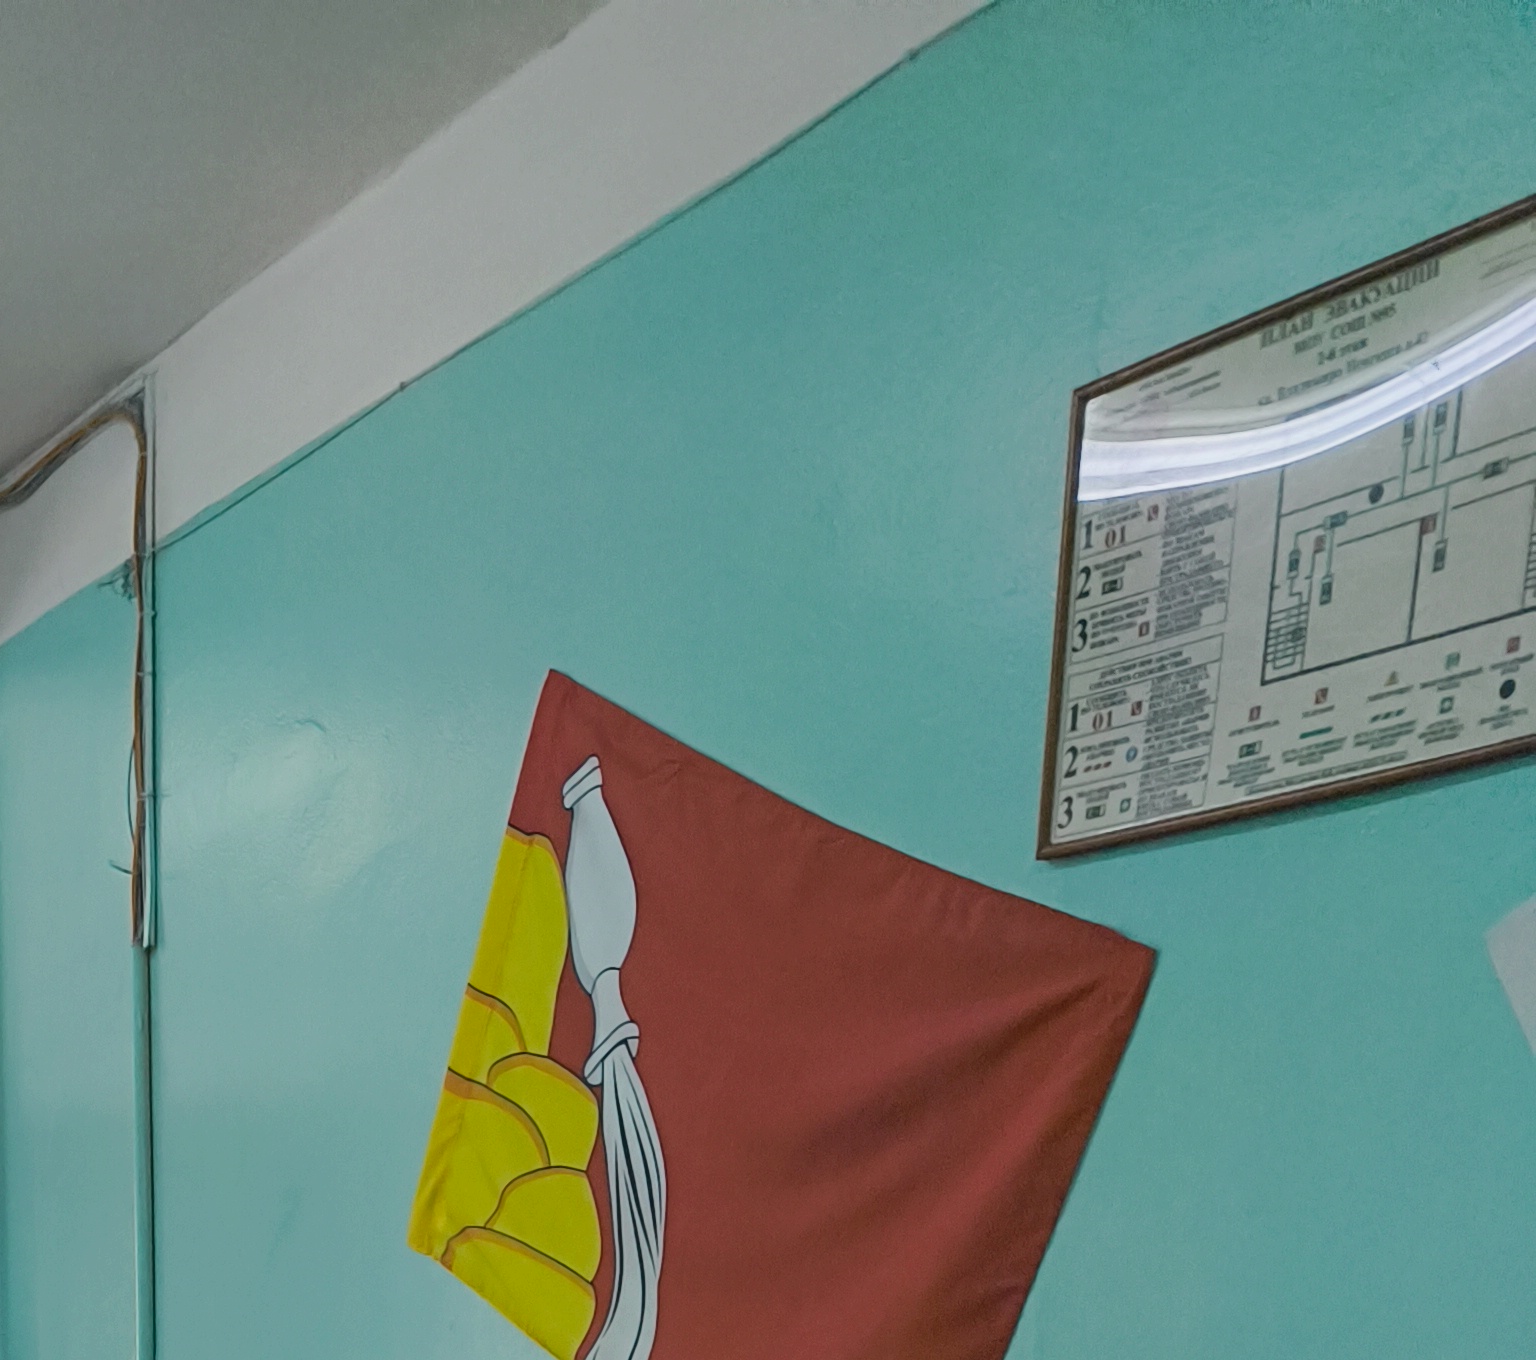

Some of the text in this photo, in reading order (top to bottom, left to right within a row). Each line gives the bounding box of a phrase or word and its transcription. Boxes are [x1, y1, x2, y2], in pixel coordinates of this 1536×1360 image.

[1325, 259, 1440, 323] ЭВАКУАЦИИ
[1082, 520, 1094, 549] 1
[1104, 525, 1127, 549] 01
[1076, 566, 1091, 600] 2
[1071, 618, 1088, 652] 3
[1069, 703, 1080, 732] 1
[1092, 710, 1114, 731] 01
[1064, 745, 1079, 778] 2
[1057, 796, 1073, 829] 3
